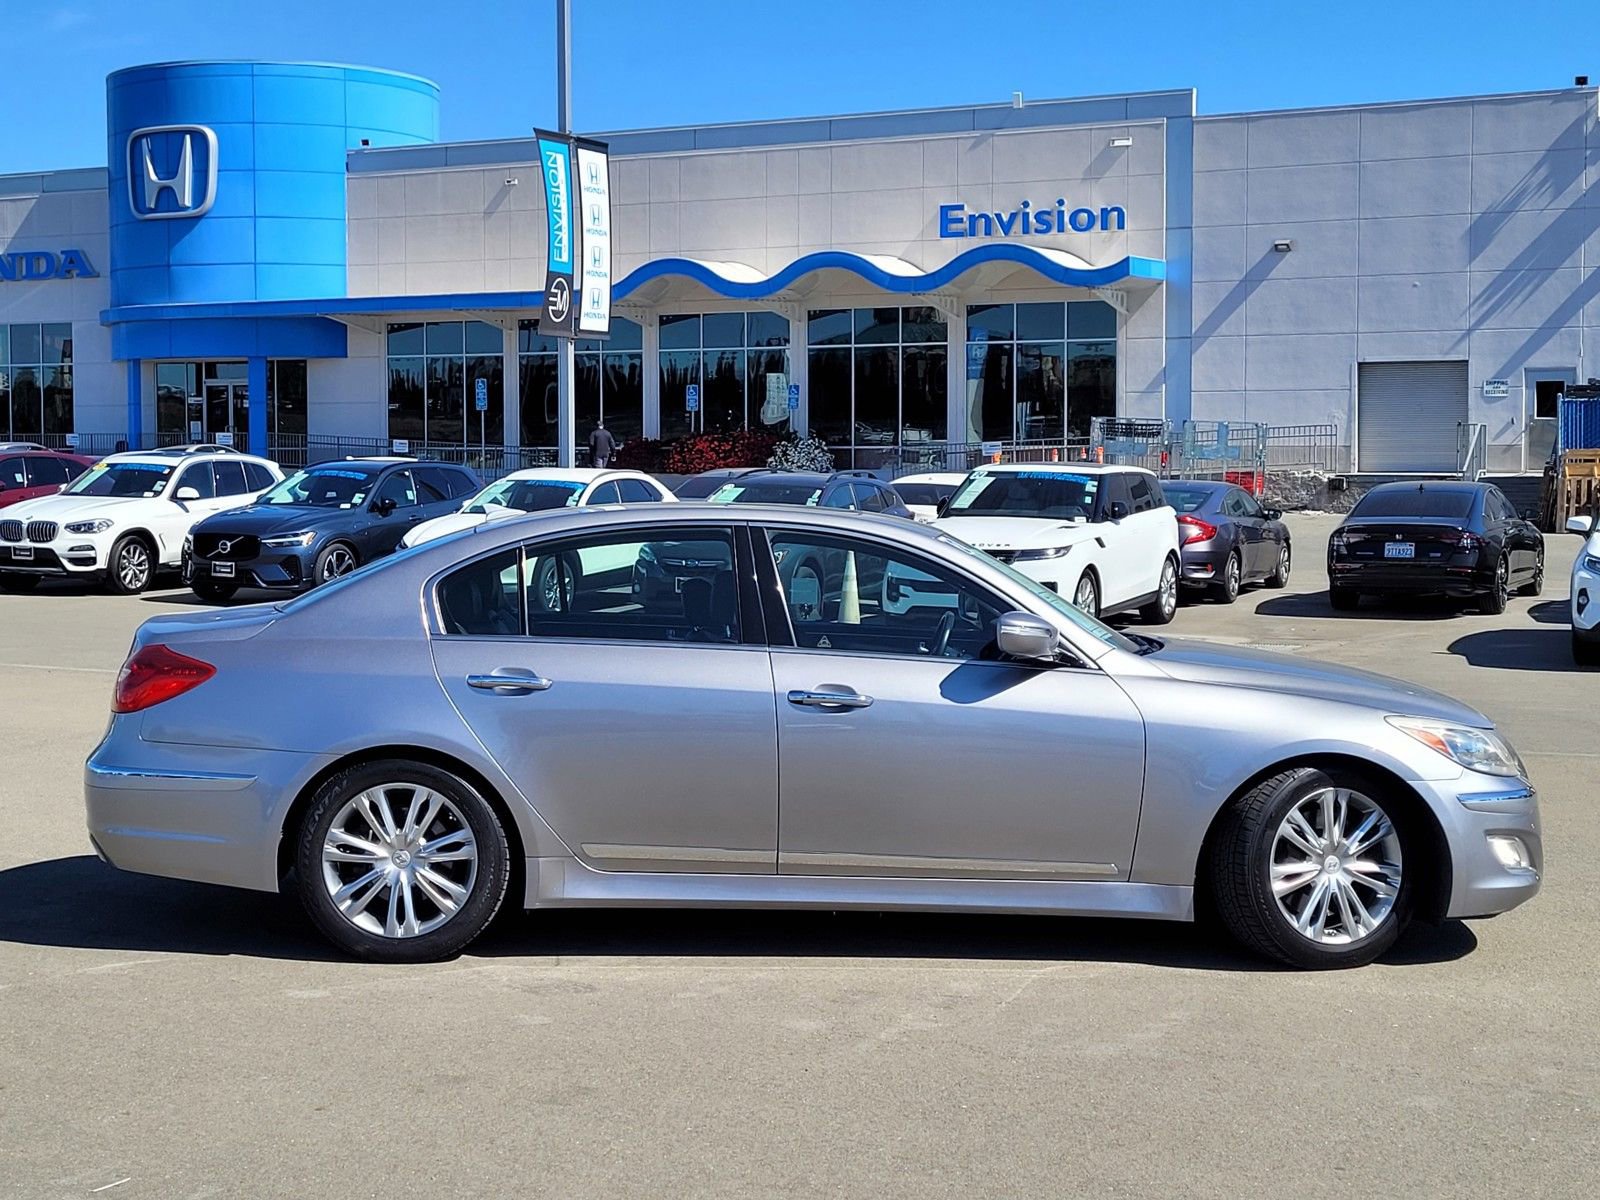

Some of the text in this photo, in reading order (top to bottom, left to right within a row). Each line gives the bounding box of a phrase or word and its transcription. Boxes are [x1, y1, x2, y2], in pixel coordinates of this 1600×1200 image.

[583, 185, 606, 195] HONDA
[546, 151, 563, 261] ENVISION
[938, 198, 1127, 239] Envision
[585, 227, 608, 237] HONDA
[585, 269, 608, 279] HONDA
[583, 311, 607, 320] HONDA
